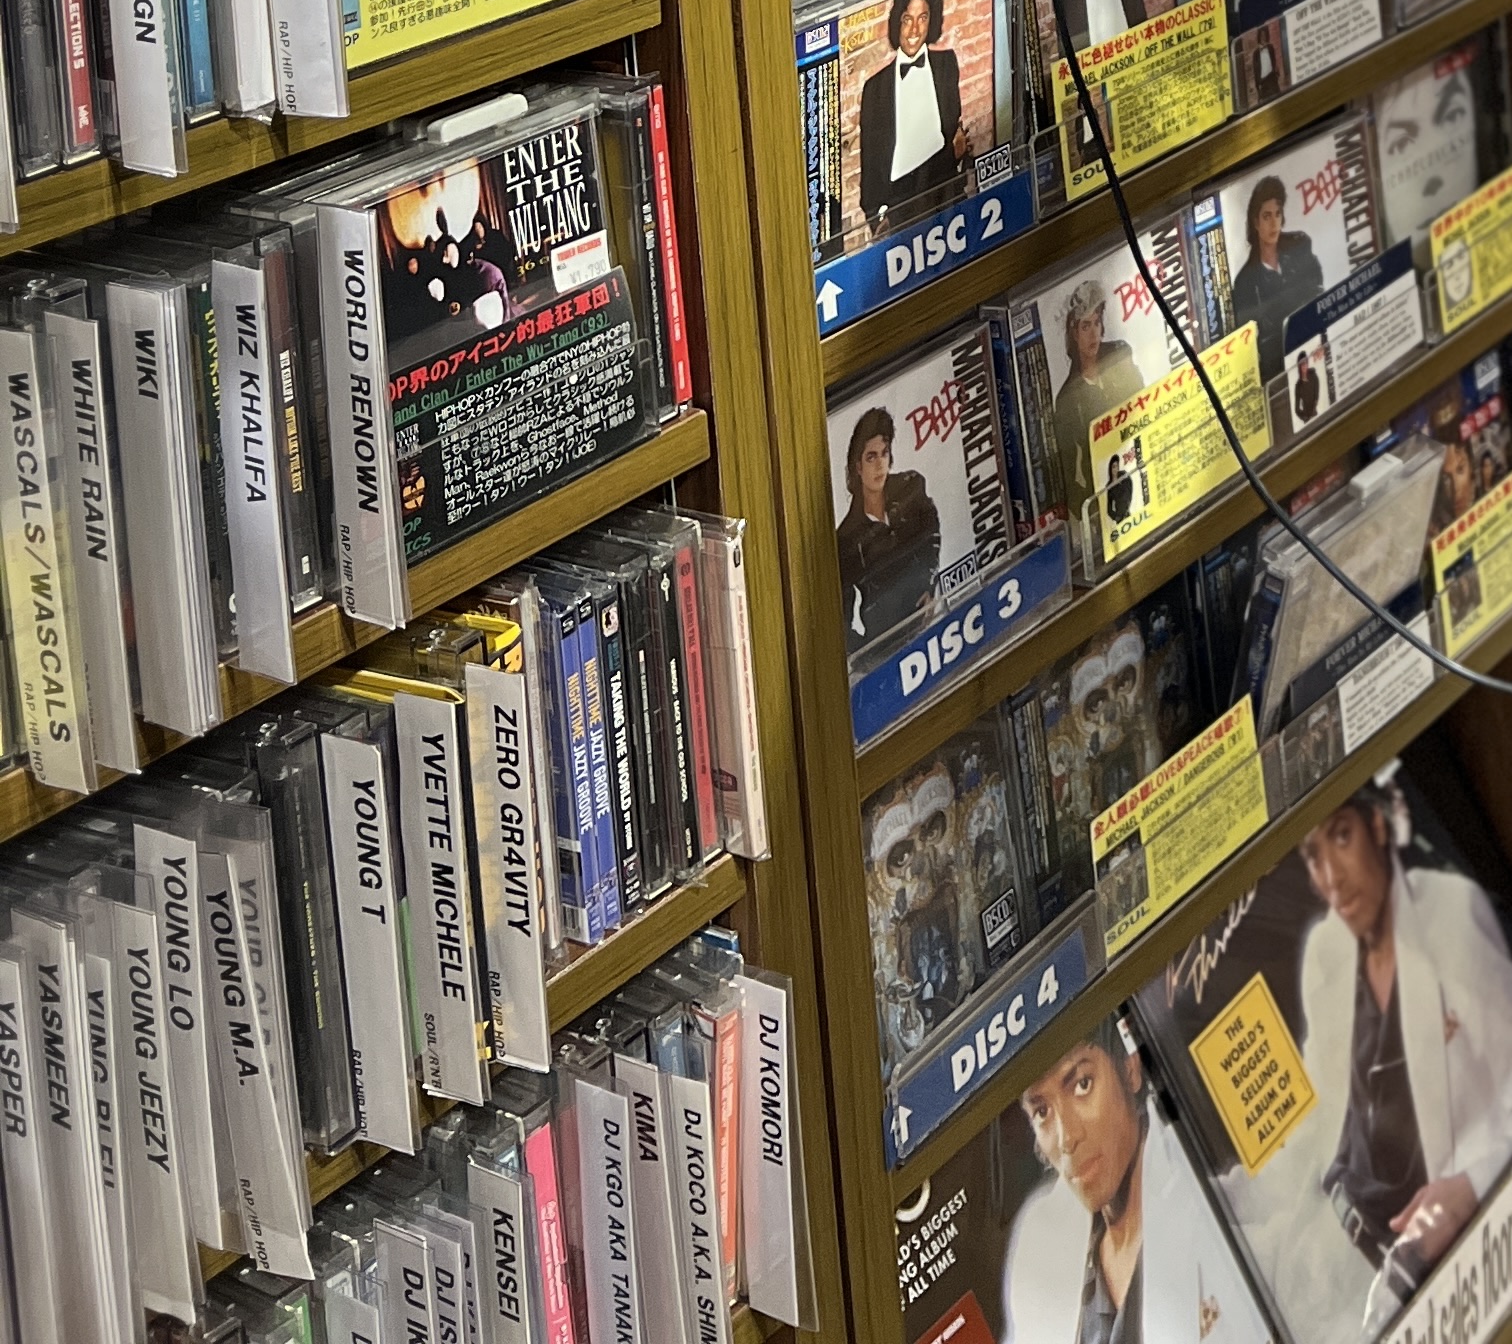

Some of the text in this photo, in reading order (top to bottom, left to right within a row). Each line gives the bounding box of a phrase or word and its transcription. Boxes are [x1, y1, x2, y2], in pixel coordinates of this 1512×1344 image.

[1101, 56, 1134, 77] JACKSON
[1145, 43, 1157, 57] OFF
[1162, 36, 1174, 50] THE
[1177, 28, 1195, 44] WALL
[503, 125, 582, 185] ENTER
[506, 159, 584, 206] THE
[1296, 159, 1346, 216] BAD
[508, 182, 591, 259] WU-TANG
[885, 197, 1004, 288] DISC 2
[134, 330, 158, 399] WIKI
[343, 249, 379, 514] WORLD RENOWN
[420, 388, 449, 414] Clan
[466, 367, 499, 392] Enter
[501, 353, 524, 376] The
[526, 326, 578, 359] Wu-Tang
[235, 304, 267, 503] WIZ KHALIFA
[905, 379, 966, 452] BAD
[71, 359, 108, 561] WHITE RAIN
[8, 374, 71, 743] WASCALS/WASCALS
[1110, 511, 1152, 543] SOUL
[899, 579, 1023, 696] DISC 3
[567, 671, 592, 834] NIGHTTIME JAZZY GROOVE
[585, 657, 609, 817] NIGHTTIME JAZZY GROOVE
[609, 671, 631, 812] TAKING THE WORLD
[493, 705, 533, 938] ZERO GR4VITY
[1141, 788, 1175, 820] JACKSON
[351, 779, 386, 924] YOUNG T
[420, 732, 466, 1002] YVETTE MICHELE
[162, 857, 195, 1032] YOUNG LO
[1107, 907, 1149, 944] SOUL
[206, 890, 260, 1087] YOUNG M.A.
[37, 964, 73, 1130] YASMEEN
[127, 947, 171, 1175] YOUNG JEEZY
[951, 964, 1060, 1093] DISC 4
[1220, 1019, 1266, 1073] WORLD'S
[1224, 1015, 1245, 1042] THE
[1231, 1039, 1272, 1090] BIGGEST
[759, 1013, 785, 1166] DJ KOMORI
[1240, 1059, 1279, 1107] SELLING
[1244, 1069, 1293, 1131] ALBUM OF
[1256, 1091, 1298, 1145] ALL TIME
[603, 1118, 621, 1149] DJ
[632, 1091, 660, 1163] KIMA
[683, 1108, 701, 1139] DJ
[604, 1156, 624, 1208] KGO
[685, 1144, 707, 1216] KOCO
[493, 1208, 520, 1323] KENSEI
[607, 1214, 628, 1263] AKA
[919, 1221, 959, 1269] ALBUM
[907, 1248, 957, 1304] ALL TIME
[1439, 1262, 1479, 1334] sales
